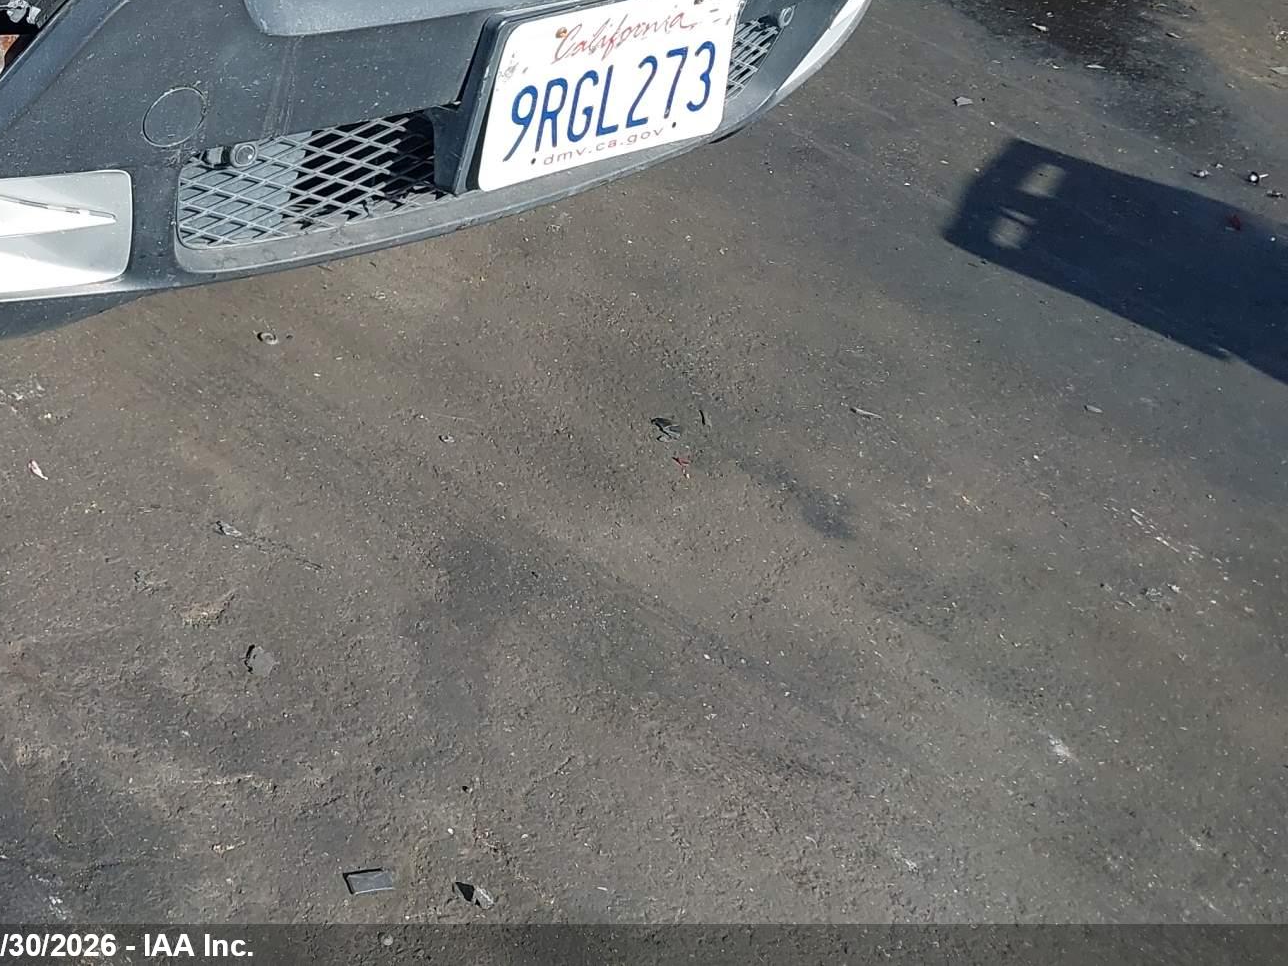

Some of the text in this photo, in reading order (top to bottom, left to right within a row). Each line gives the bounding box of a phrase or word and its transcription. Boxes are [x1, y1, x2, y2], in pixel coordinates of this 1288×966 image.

[552, 7, 695, 65] California
[503, 40, 716, 162] 9RGL273
[543, 127, 664, 166] dmv.ca.gov
